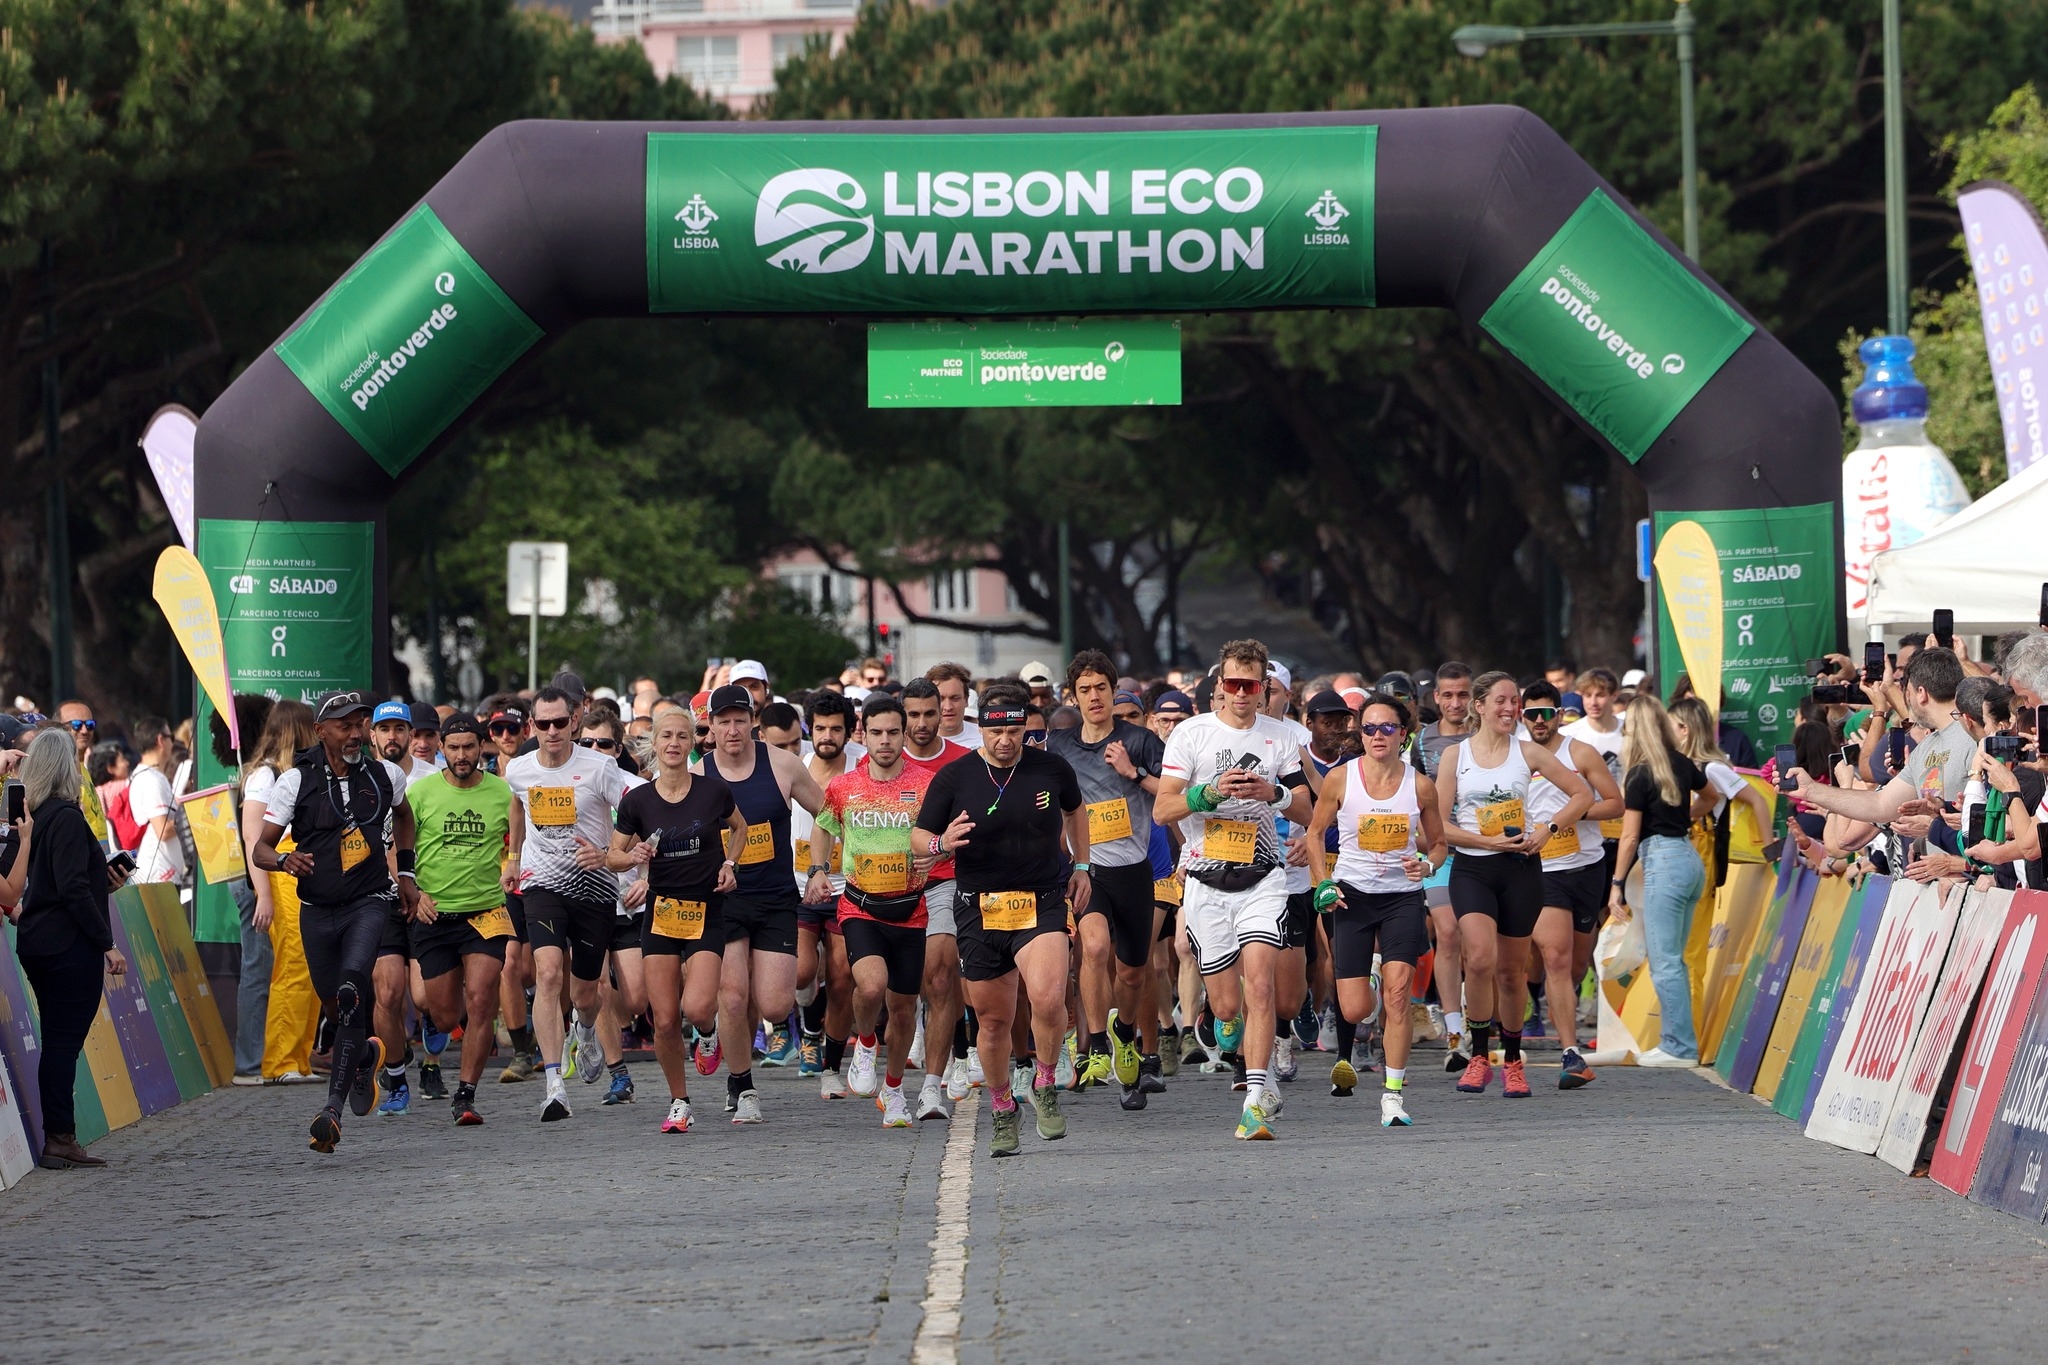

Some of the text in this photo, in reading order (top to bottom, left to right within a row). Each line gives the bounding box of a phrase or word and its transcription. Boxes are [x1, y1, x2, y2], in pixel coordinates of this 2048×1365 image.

[884, 165, 1264, 218] LISBON ECO
[673, 237, 720, 249] LISBOA
[1304, 233, 1350, 245] LISBOA
[884, 226, 1265, 276] MARATHON
[1556, 264, 1601, 304] sociedade
[1539, 276, 1655, 379] pontoverde
[350, 302, 458, 411] pontoverde
[981, 349, 1028, 360] sociedade
[943, 359, 963, 367] ECO
[339, 349, 381, 392] sociedade
[920, 368, 963, 377] PARTNER
[980, 361, 1108, 385] pontoverde
[1735, 546, 1779, 556] PARTNERS
[245, 559, 317, 567] MEDIA PARTNERS
[1732, 563, 1802, 583] SÁBADO
[269, 575, 338, 595] SÁBADO
[1747, 596, 1786, 606] TÉCNICO
[240, 608, 320, 618] PARCEIRO TÉCNICO
[1752, 656, 1789, 666] OFICIAIS
[237, 669, 321, 678] PARCEIROS OFICIAIS
[1731, 677, 1752, 697] illy
[380, 706, 403, 715] HOKA
[548, 796, 572, 807] 1129
[851, 811, 911, 828] KENYA
[1100, 808, 1126, 823] 1637
[1498, 807, 1522, 822] 1667
[444, 822, 484, 832] TRAIL
[1381, 823, 1408, 834] 1735
[746, 833, 771, 846] 1680
[1227, 831, 1253, 843] 1737
[341, 839, 367, 852] 1491
[877, 863, 905, 874] 1046
[1006, 898, 1033, 910] 1071
[676, 911, 703, 921] 1699
[1844, 895, 1939, 1082] Vitalis
[1906, 903, 1984, 1098] Vitalis
